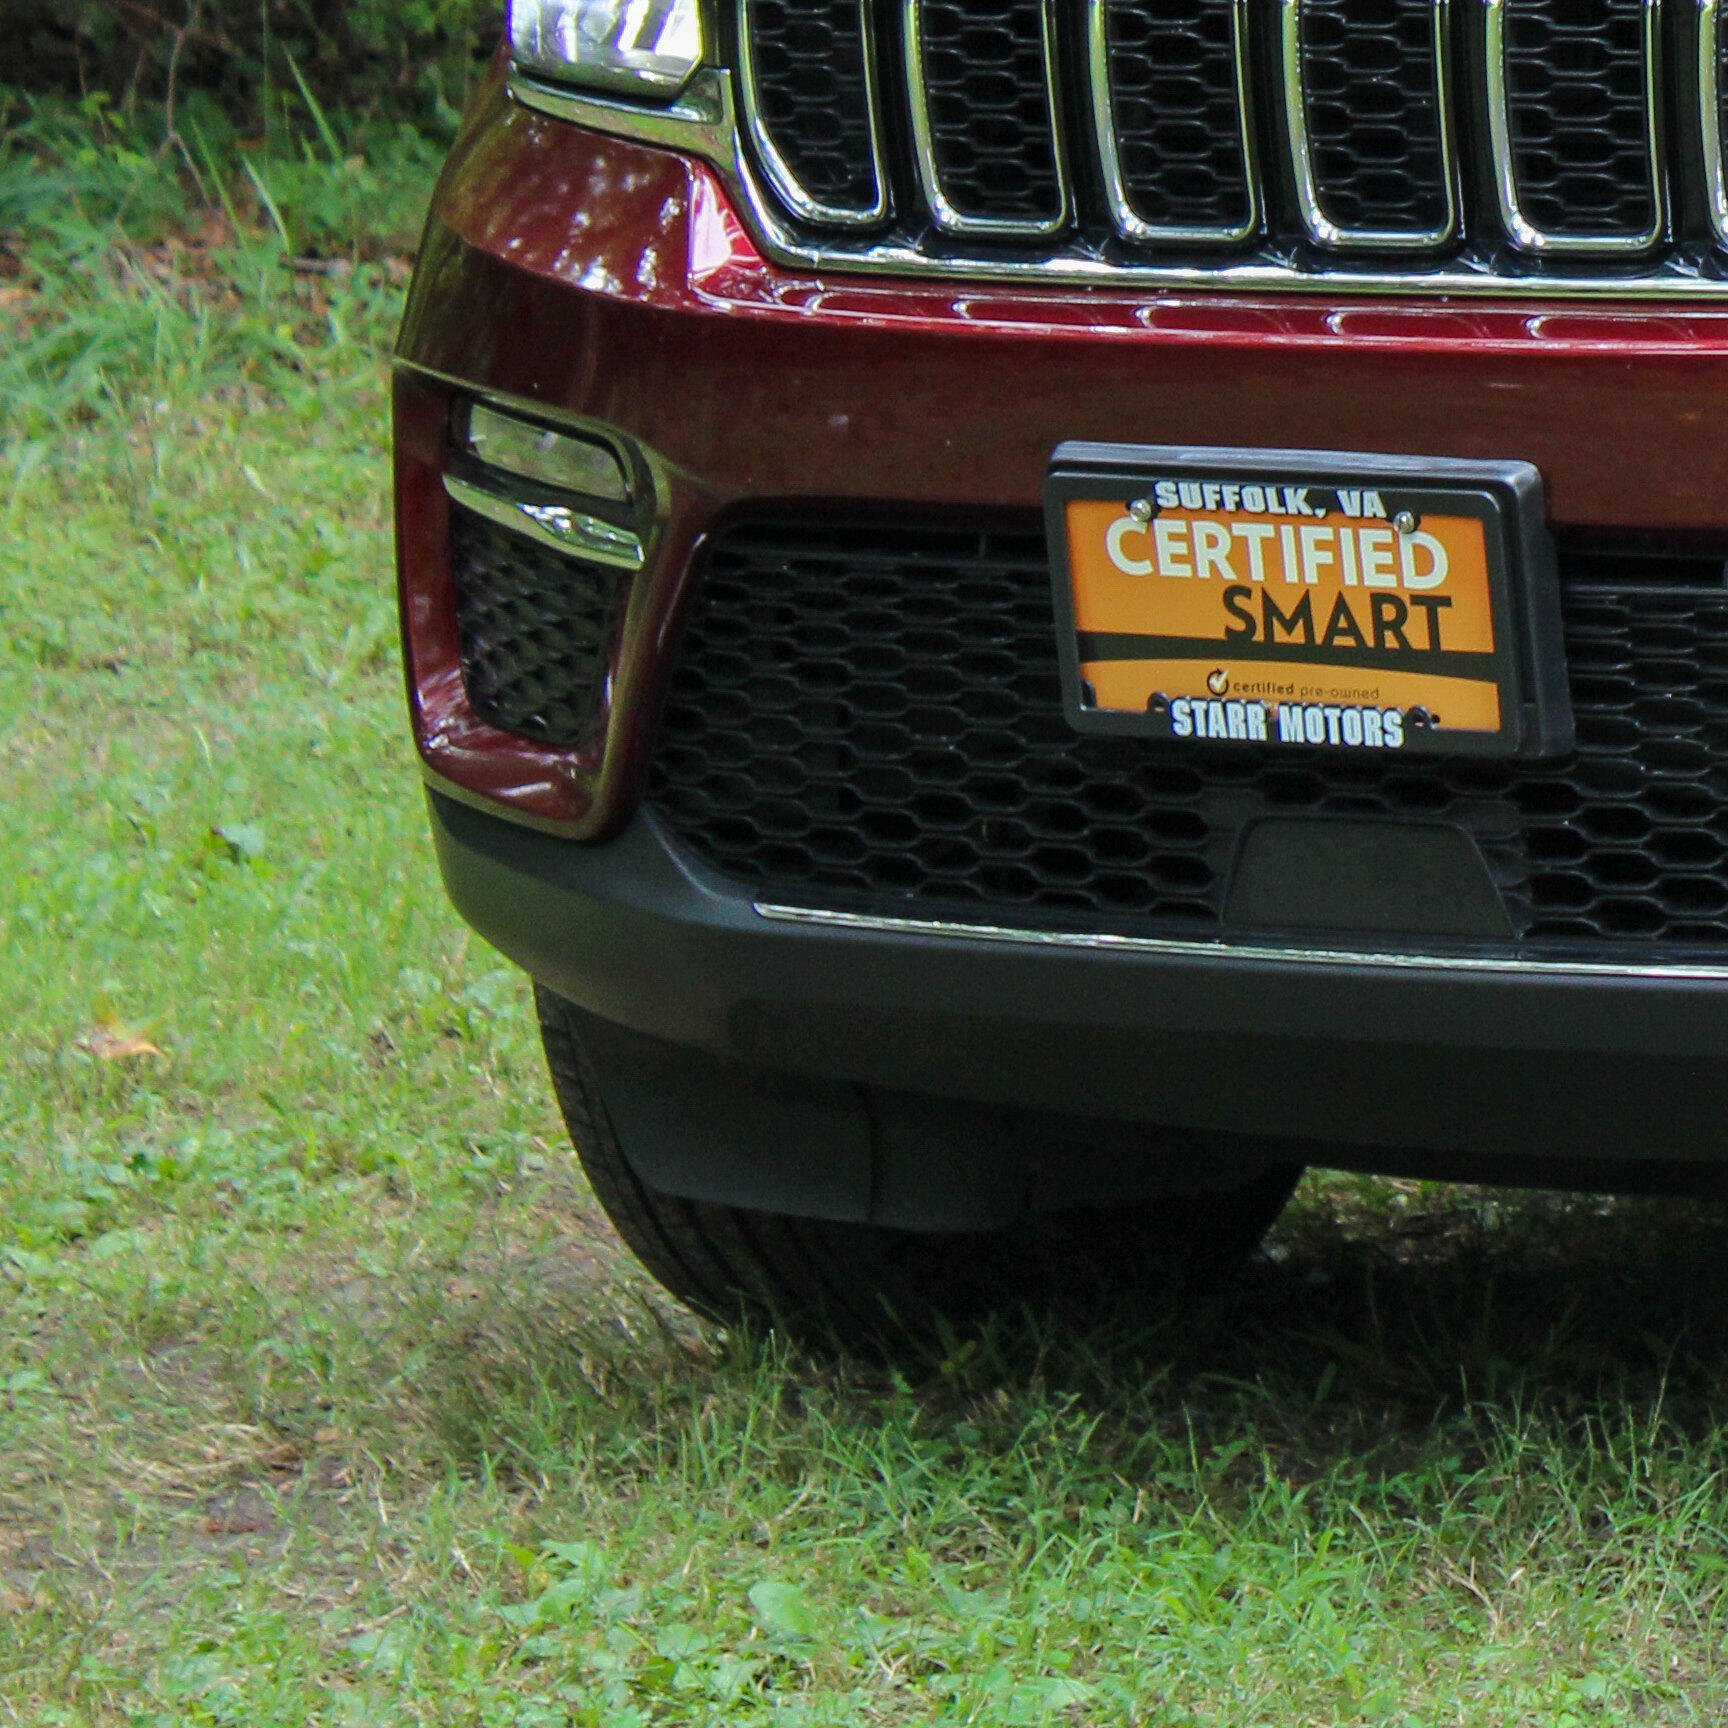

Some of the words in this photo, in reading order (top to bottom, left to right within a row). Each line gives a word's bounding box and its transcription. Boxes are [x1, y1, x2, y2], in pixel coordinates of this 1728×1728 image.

[1154, 480, 1327, 521] SUFFOLK,
[1336, 487, 1387, 520] VA
[1105, 516, 1449, 590] CERTIFIED
[1221, 585, 1453, 654] SMART
[1233, 680, 1295, 695] certified
[1300, 685, 1380, 701] pre-owned
[1170, 697, 1268, 742] STARR
[1278, 703, 1405, 750] MOTORS
